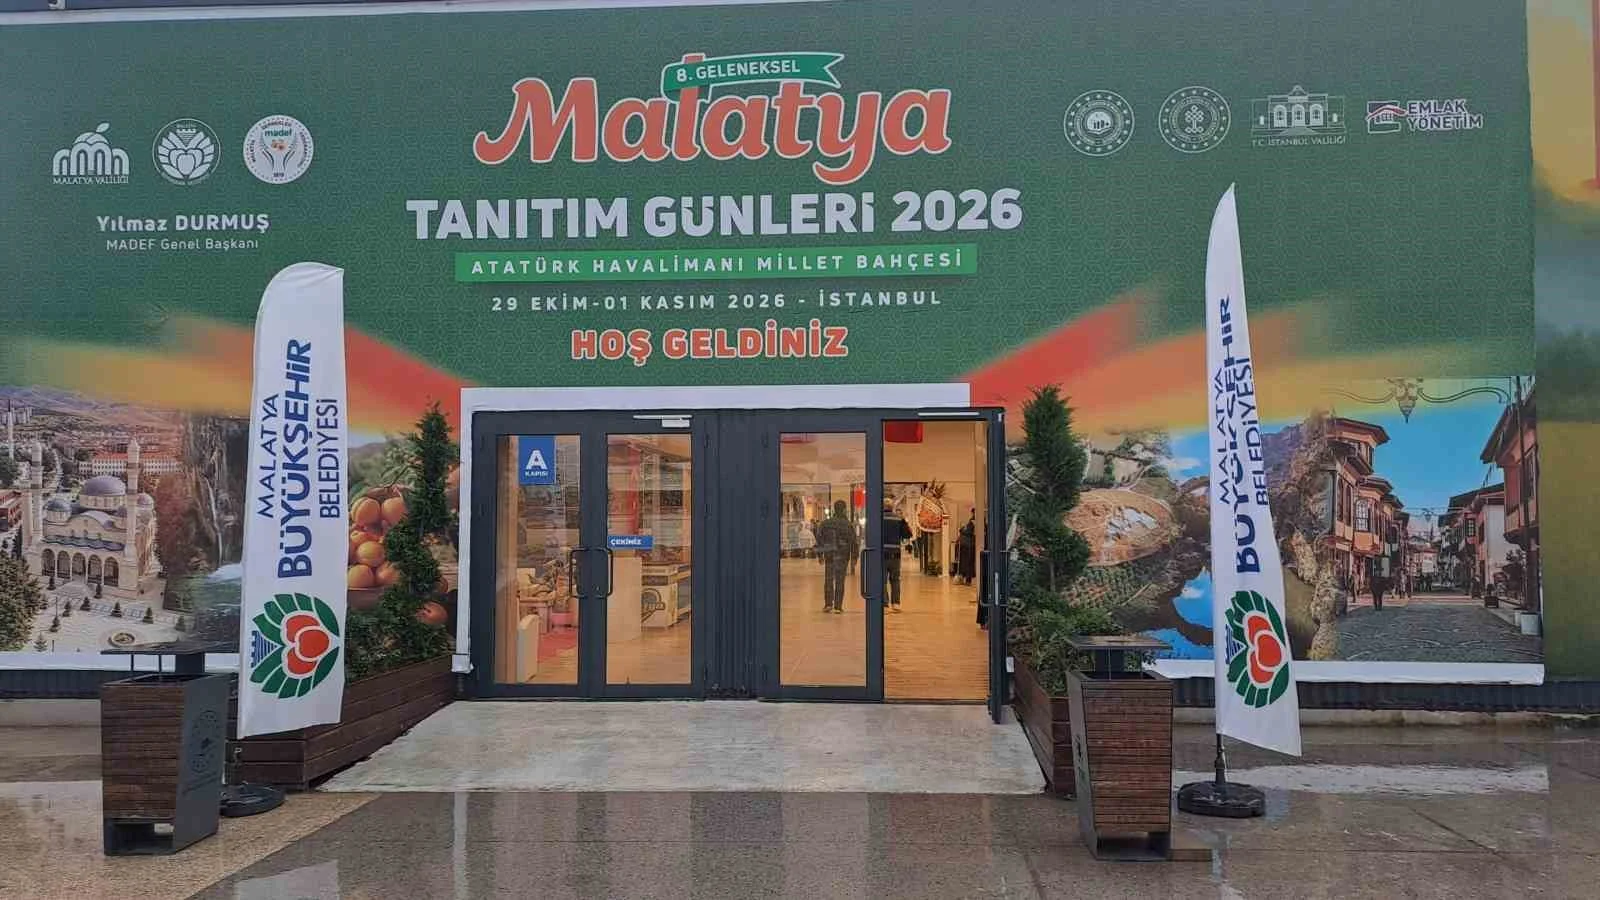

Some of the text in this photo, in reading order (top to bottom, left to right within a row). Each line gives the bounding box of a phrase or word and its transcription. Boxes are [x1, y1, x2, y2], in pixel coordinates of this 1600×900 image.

[676, 60, 801, 82] 8. GELENEKSEL
[1408, 99, 1467, 114] EMLAK
[473, 53, 951, 185] Malatya
[1407, 112, 1483, 130] YÖNETİM
[53, 176, 92, 185] MALATYA
[97, 213, 270, 234] Yılmaz DURMUŞ
[406, 188, 1023, 240] TANITIM GÜNLERİ 2026
[106, 238, 259, 252] MADEF Genel Başkanı
[471, 248, 961, 275] ATATÜRK HAVALİMANI MİLLET BAHÇESİ
[491, 296, 519, 312] 29
[531, 292, 628, 311] EKİM-01
[640, 294, 715, 311] KASIM
[728, 293, 786, 309] 2026
[819, 288, 941, 307] İSTANBUL
[571, 318, 849, 366] HOŞ GELDİNİZ
[1214, 367, 1230, 505] MALATYA
[257, 392, 280, 519] MALATYA
[277, 338, 313, 580] BÜYÜKŞEHİR
[315, 397, 341, 520] BELEDİYESİ
[525, 449, 548, 470] A
[610, 537, 642, 547] ÇEKİNİZ
